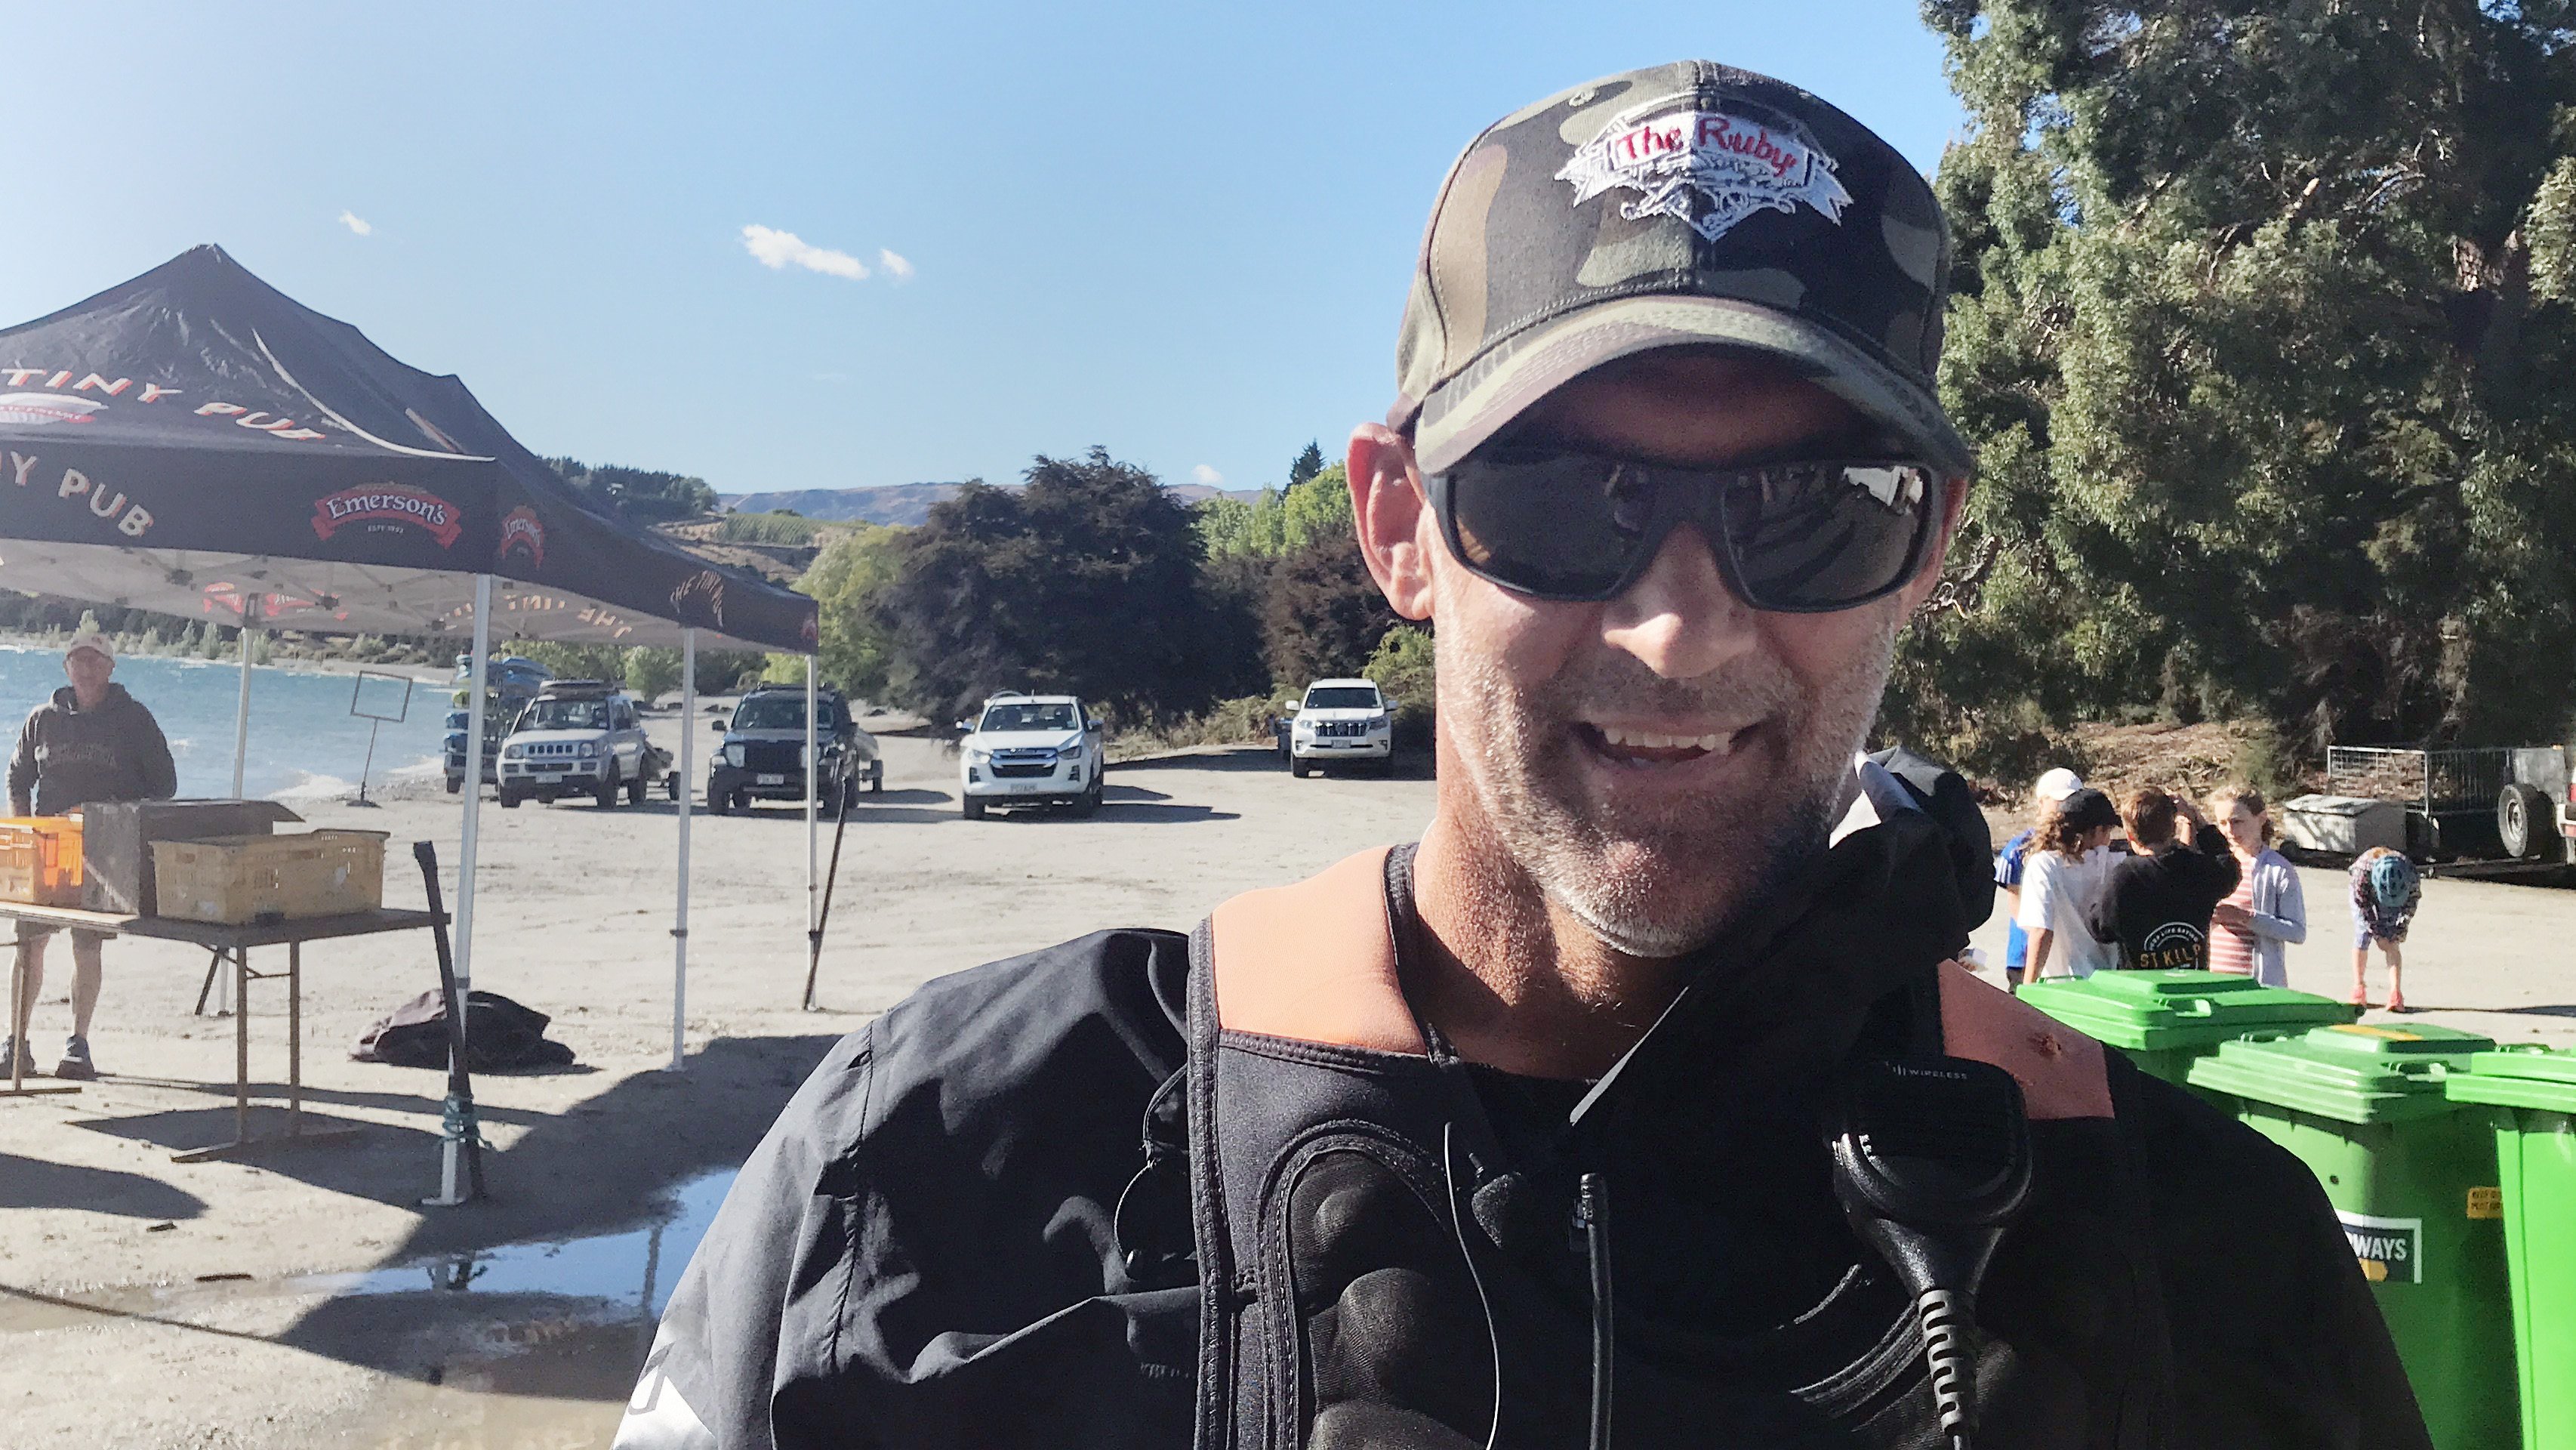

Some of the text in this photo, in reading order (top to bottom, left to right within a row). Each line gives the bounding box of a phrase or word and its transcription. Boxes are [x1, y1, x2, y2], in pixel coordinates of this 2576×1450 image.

[1616, 116, 1798, 178] The Ruby
[1, 368, 183, 403] TINY
[1, 451, 155, 537] Y PUB
[326, 494, 448, 526] Emerson's
[1909, 1068, 1967, 1079] WIRELESS
